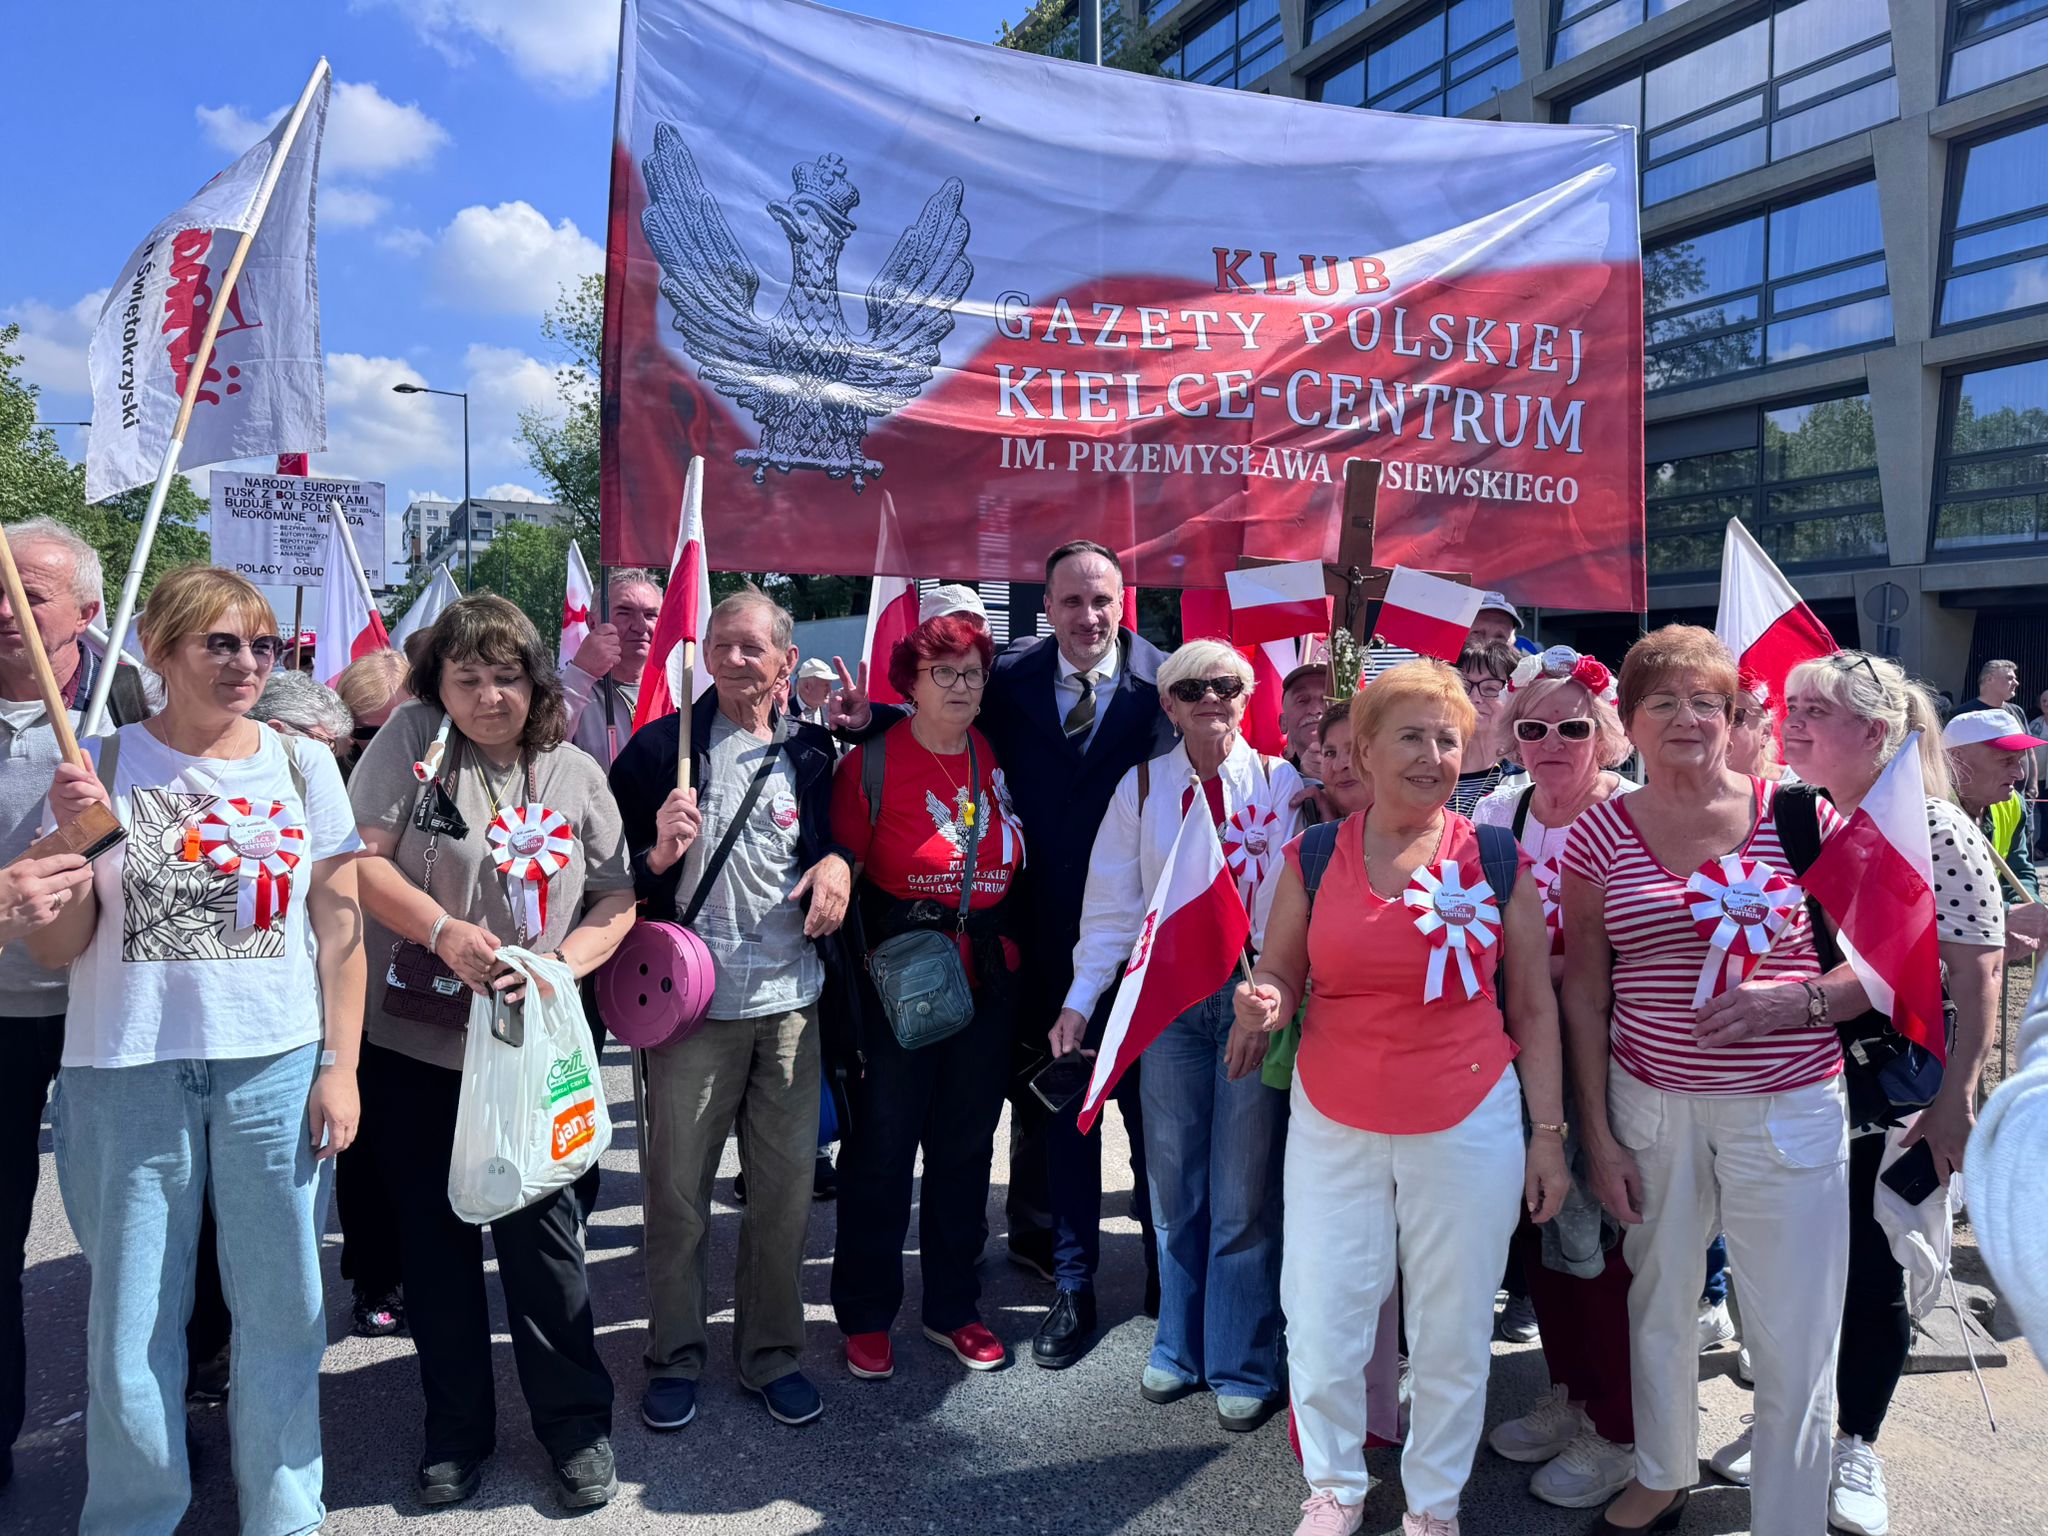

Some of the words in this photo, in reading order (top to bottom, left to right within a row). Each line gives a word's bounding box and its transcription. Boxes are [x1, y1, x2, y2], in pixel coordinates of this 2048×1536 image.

[1212, 247, 1391, 296] KLUB
[995, 291, 1265, 350] GAZETY
[1297, 306, 1584, 385] POLSKIEJ
[119, 261, 157, 430] Świętokrzyski
[995, 363, 1585, 454] KIELCE-CENTRUM
[1000, 437, 1055, 471] IM.
[1067, 440, 1333, 484] PRZEMYSŁAWA
[245, 478, 295, 490] NARODY
[224, 487, 255, 497] TUSK
[262, 490, 269, 498] Z
[276, 491, 369, 505] BOLSZEWIKAMI
[225, 498, 273, 510] BUDUJE
[281, 501, 293, 511] W
[302, 502, 347, 514] POLSE
[280, 531, 329, 540] AUTORYTARYZ
[236, 563, 282, 575] POLACY
[293, 566, 324, 576] OBUD
[431, 819, 453, 831] EKI
[240, 841, 275, 851] CENTRUM
[907, 874, 956, 884] GAZETY
[909, 881, 1005, 894] KIELCE-CNTRUM
[1728, 909, 1761, 920] CENTRUM
